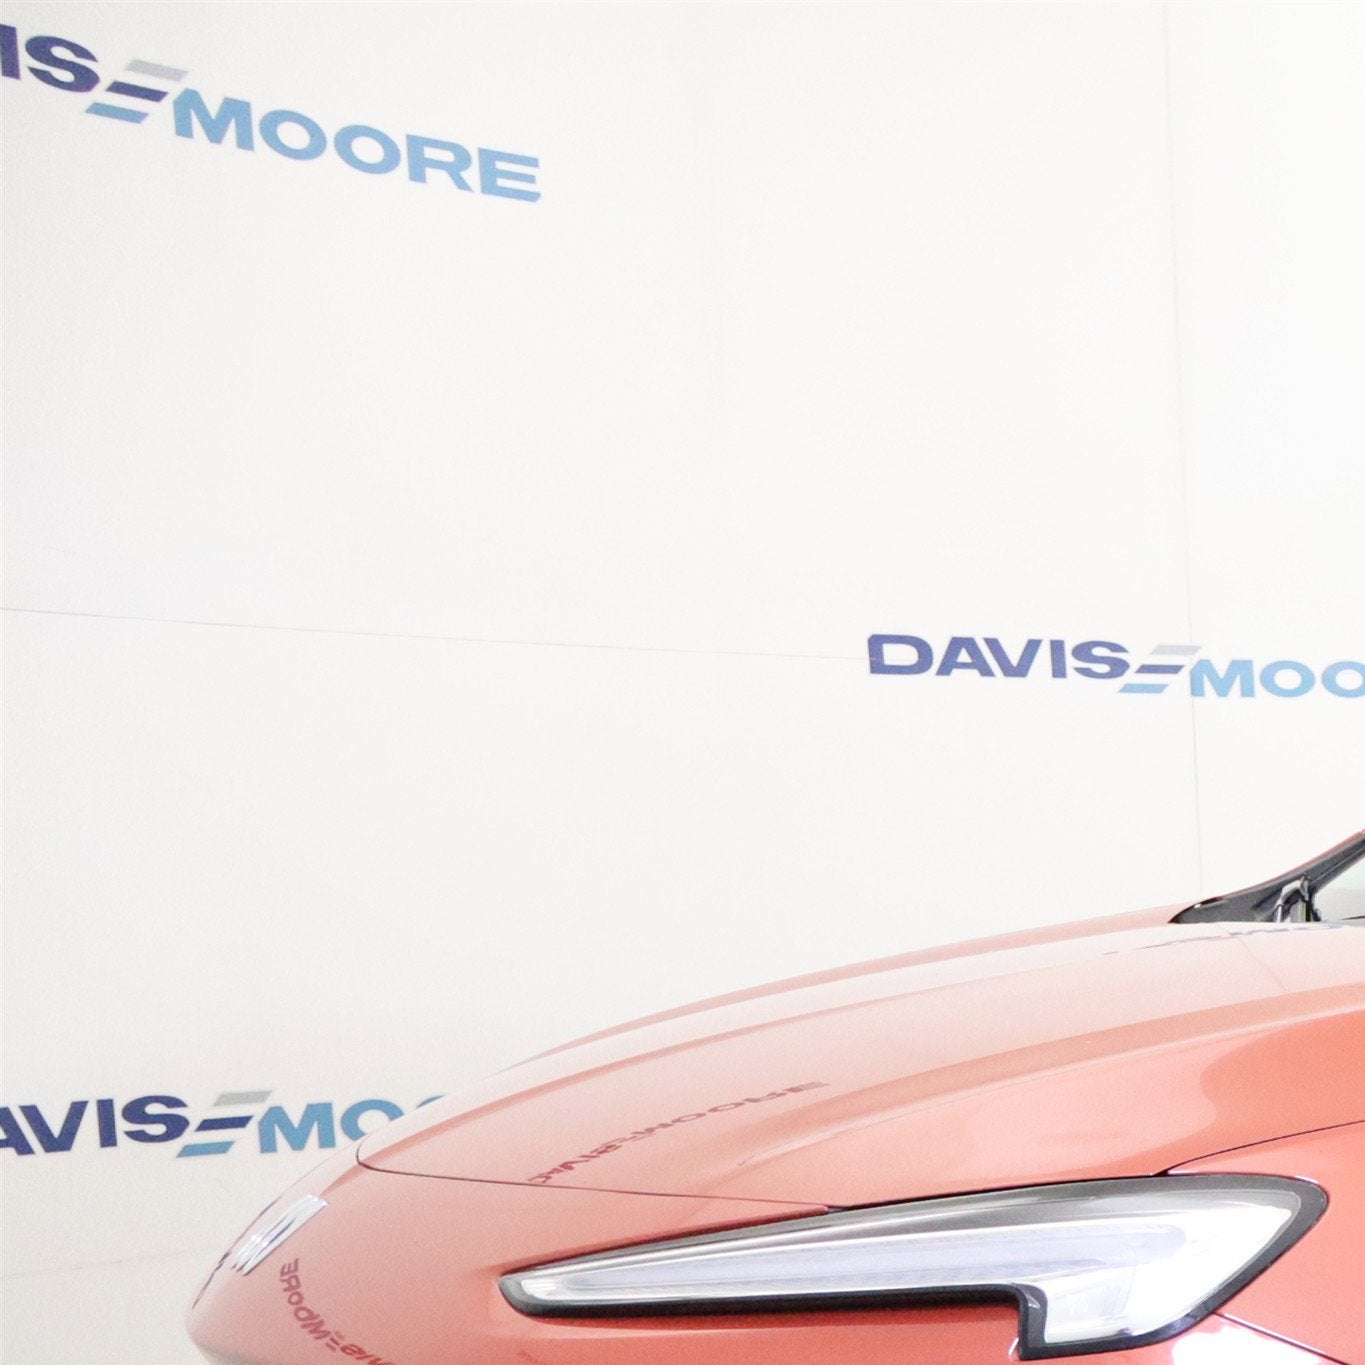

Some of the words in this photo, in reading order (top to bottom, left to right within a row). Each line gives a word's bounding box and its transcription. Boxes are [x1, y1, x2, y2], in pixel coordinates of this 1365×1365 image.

[172, 87, 543, 204] MOORE
[867, 633, 1132, 681] DAVIS
[257, 1095, 448, 1155] MO
